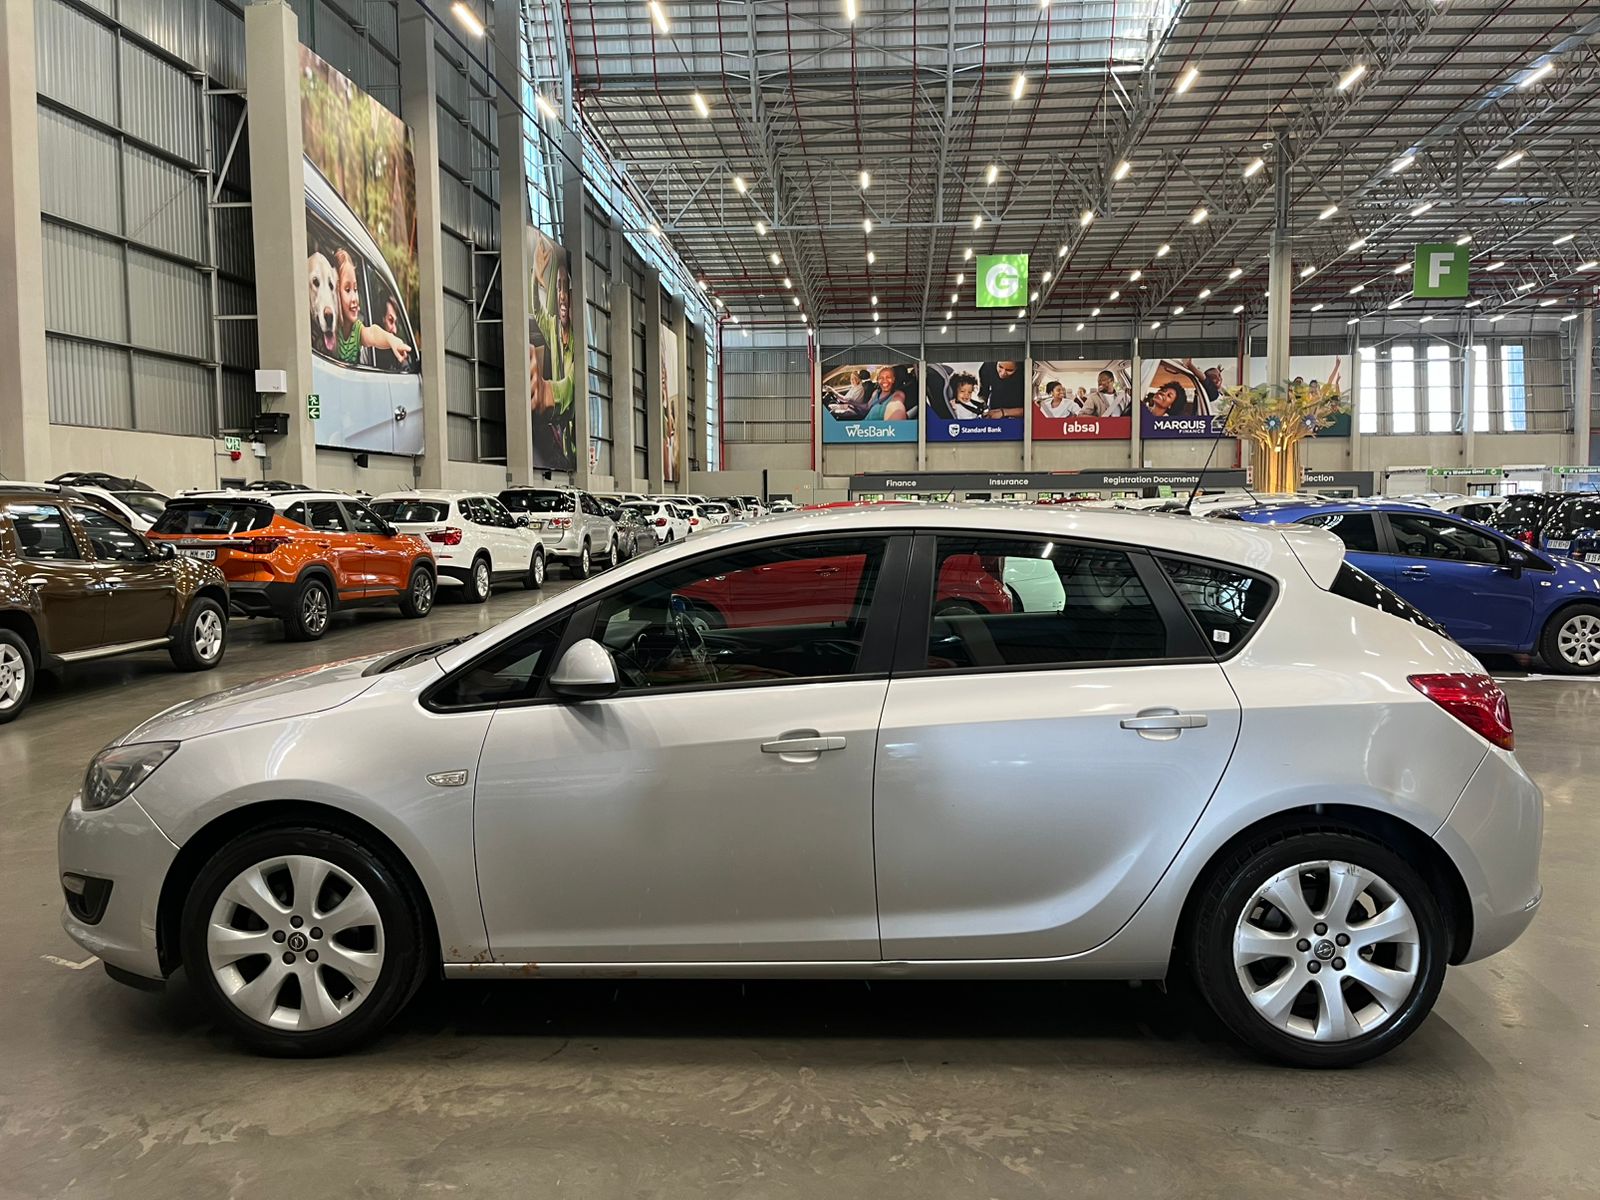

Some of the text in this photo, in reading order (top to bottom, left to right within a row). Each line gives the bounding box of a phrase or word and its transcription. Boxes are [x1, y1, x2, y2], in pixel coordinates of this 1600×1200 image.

[1428, 252, 1455, 288] F
[986, 263, 1019, 298] G
[1154, 420, 1206, 430] MARQUIS
[845, 424, 896, 437] WesBank
[886, 479, 917, 487] Finance
[989, 478, 1029, 486] Insurance
[1103, 475, 1200, 485] Registration Documents
[205, 550, 215, 559] GP
